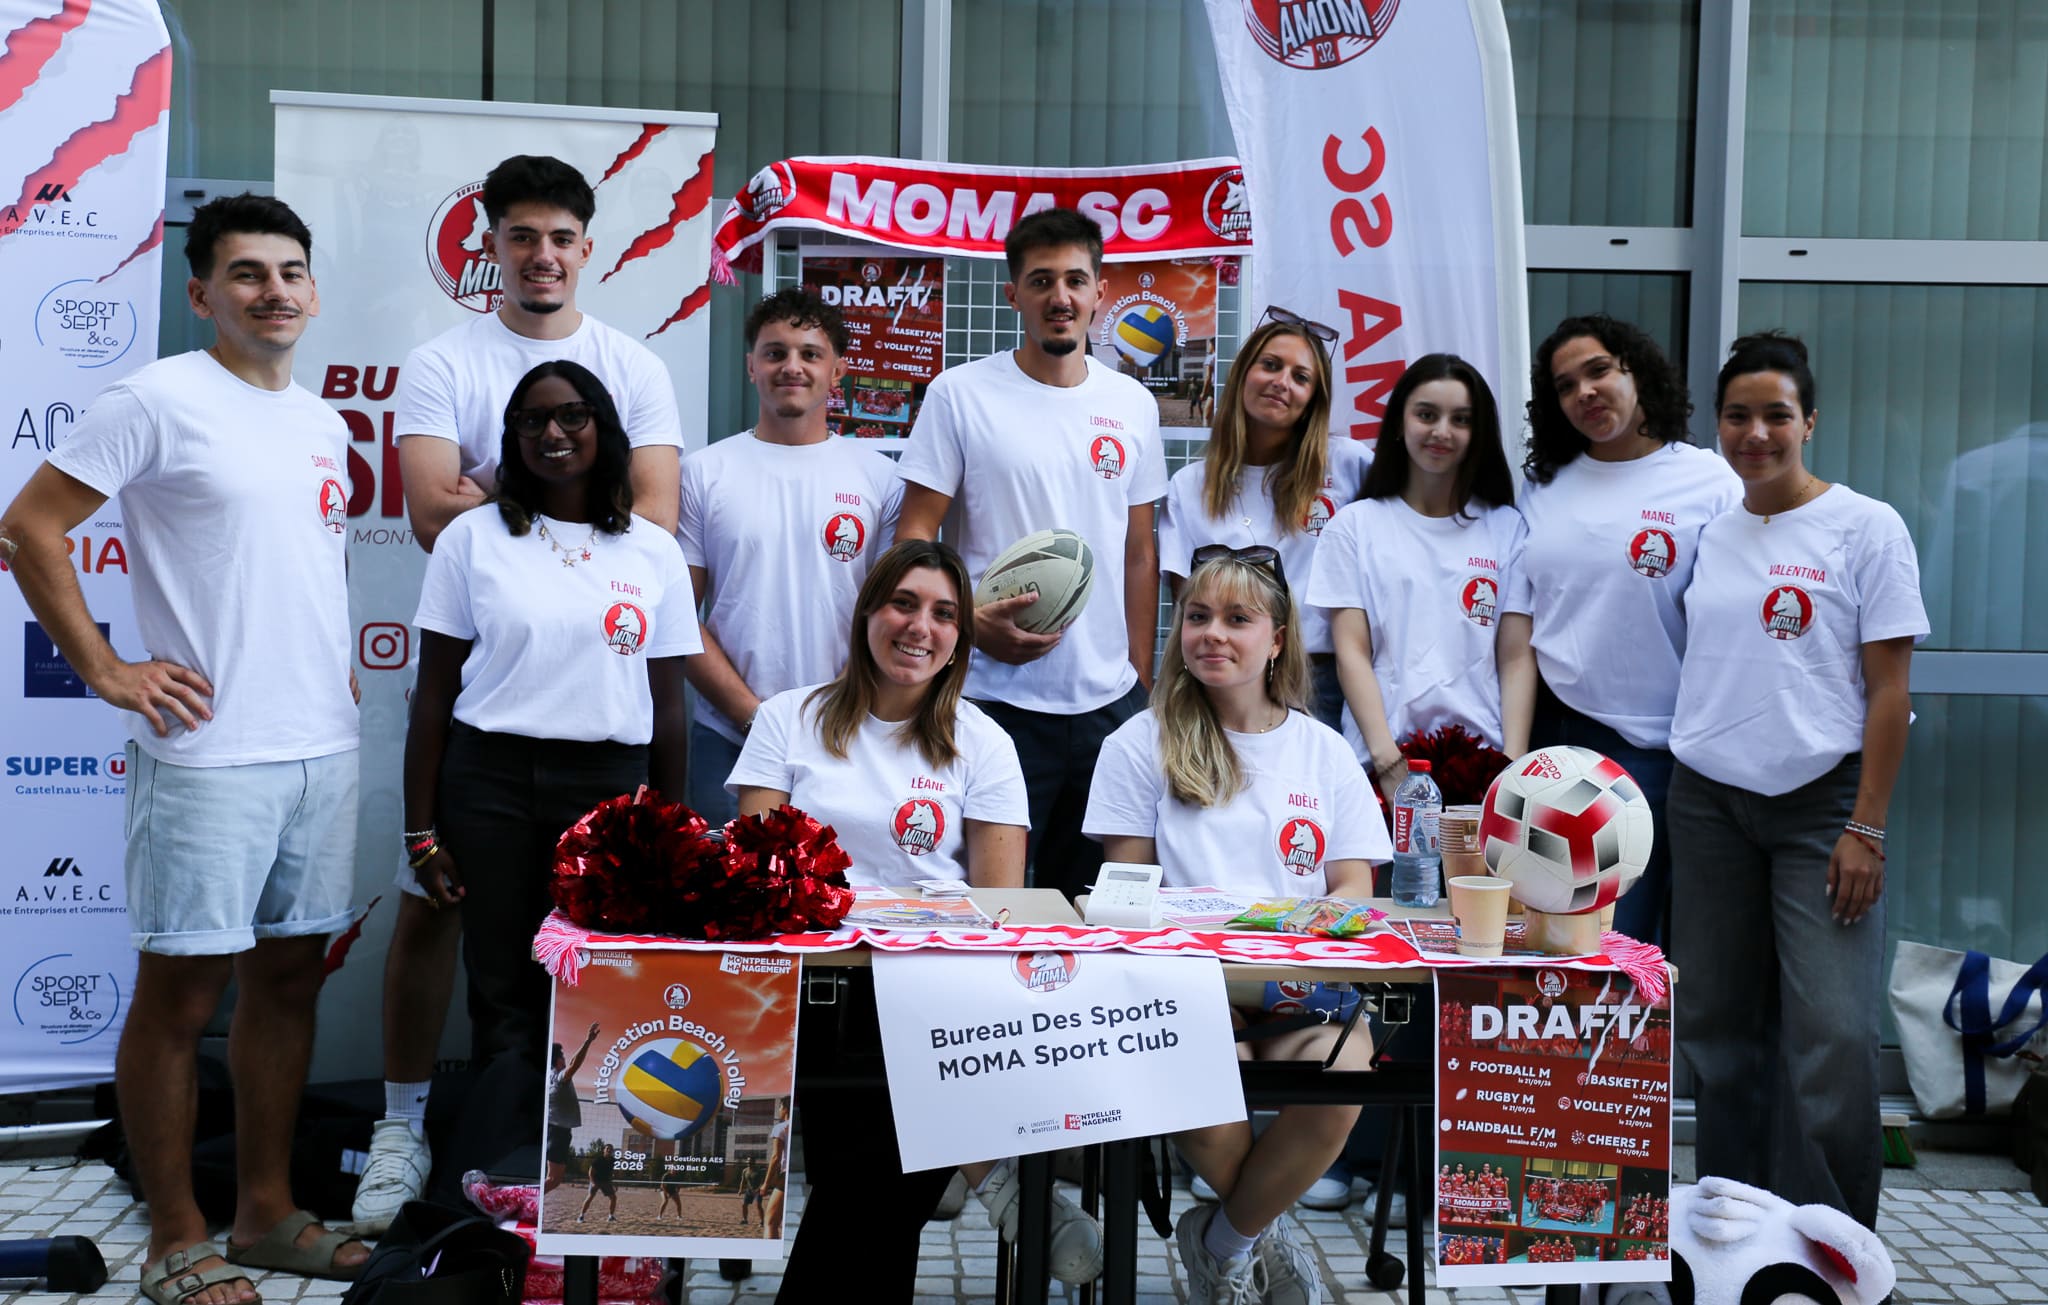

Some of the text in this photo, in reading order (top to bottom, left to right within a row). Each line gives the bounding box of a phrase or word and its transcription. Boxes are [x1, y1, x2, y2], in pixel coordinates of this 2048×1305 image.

[1077, 188, 1172, 244] SC
[1220, 211, 1251, 234] MOM
[67, 230, 119, 240] Commerces
[821, 285, 925, 308] DRAFT
[52, 299, 120, 316] SPORT
[60, 315, 112, 331] SEPT
[1101, 290, 1190, 347] Integration Beach Volley
[894, 328, 924, 337] BASKET
[884, 342, 914, 352] VOLLEY
[892, 363, 923, 373] CHEERS
[1089, 416, 1125, 430] LORENZO
[835, 492, 861, 506] HUGO
[1641, 509, 1676, 526] MANEL
[353, 528, 416, 545] MONT
[1467, 556, 1498, 571] ARIAN
[1768, 563, 1826, 583] VALENTINA
[610, 580, 645, 599] FLAVIE
[1767, 613, 1802, 638] MOMA
[6, 756, 99, 777] SUPER
[1537, 752, 1562, 780] adidas
[15, 784, 126, 796] Castelnau-le-Lez
[911, 775, 947, 792] LÉANE
[1288, 792, 1320, 811] ADÈLE
[1397, 811, 1408, 845] Vittel
[899, 827, 936, 852] MOMA
[1285, 847, 1317, 873] MOMA
[14, 906, 67, 916] Entreprises
[69, 906, 79, 915] et
[32, 975, 101, 992] SPORT
[1028, 965, 1070, 988] MOMA
[40, 990, 94, 1007] SEPT
[930, 998, 1178, 1049] Bureau Des Sports
[1471, 1004, 1641, 1041] DRAFT
[593, 1014, 747, 1110] Integration Beach Volley
[938, 1027, 1180, 1081] MOMA Sport Club
[1470, 1060, 1551, 1078] FOOTBALL M
[1590, 1074, 1668, 1094] BASKET F/M
[1476, 1089, 1534, 1105] RUGBY M
[1573, 1098, 1651, 1119] VOLLEY F/M
[1457, 1119, 1556, 1141] HANDBALL F/M
[1587, 1133, 1651, 1149] CHEERS F
[614, 1150, 646, 1163] 9 Sep
[673, 1155, 701, 1163] Gestion
[613, 1161, 644, 1171] 2026
[1635, 1220, 1646, 1230] 30
